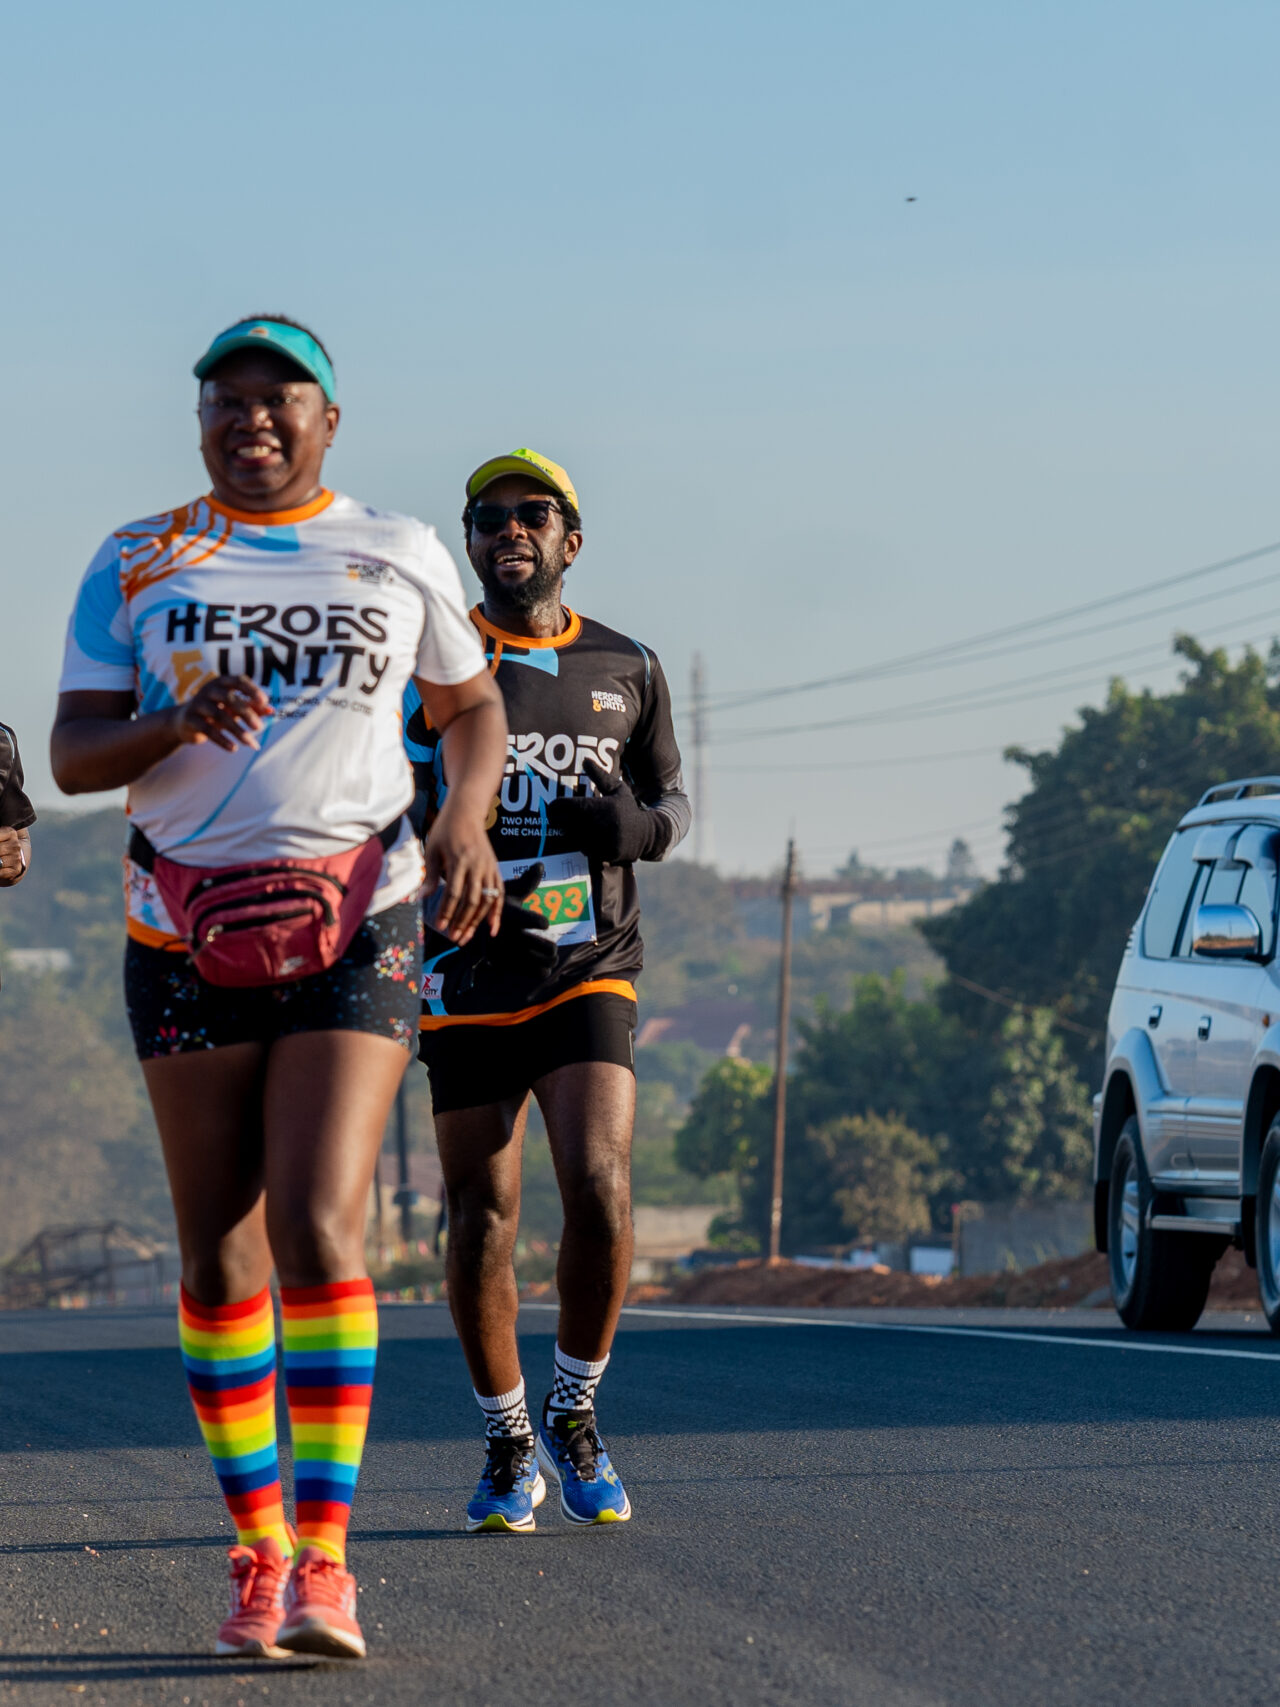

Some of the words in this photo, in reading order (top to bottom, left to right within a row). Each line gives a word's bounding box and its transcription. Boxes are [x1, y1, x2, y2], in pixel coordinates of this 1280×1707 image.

[166, 603, 389, 647] HEROES
[219, 644, 391, 695] UNITY
[591, 690, 624, 704] HEROES
[504, 731, 620, 777] EROES
[500, 773, 604, 813] UNIT
[500, 816, 523, 826] TWO
[500, 827, 520, 836] ONE
[522, 887, 585, 921] 393
